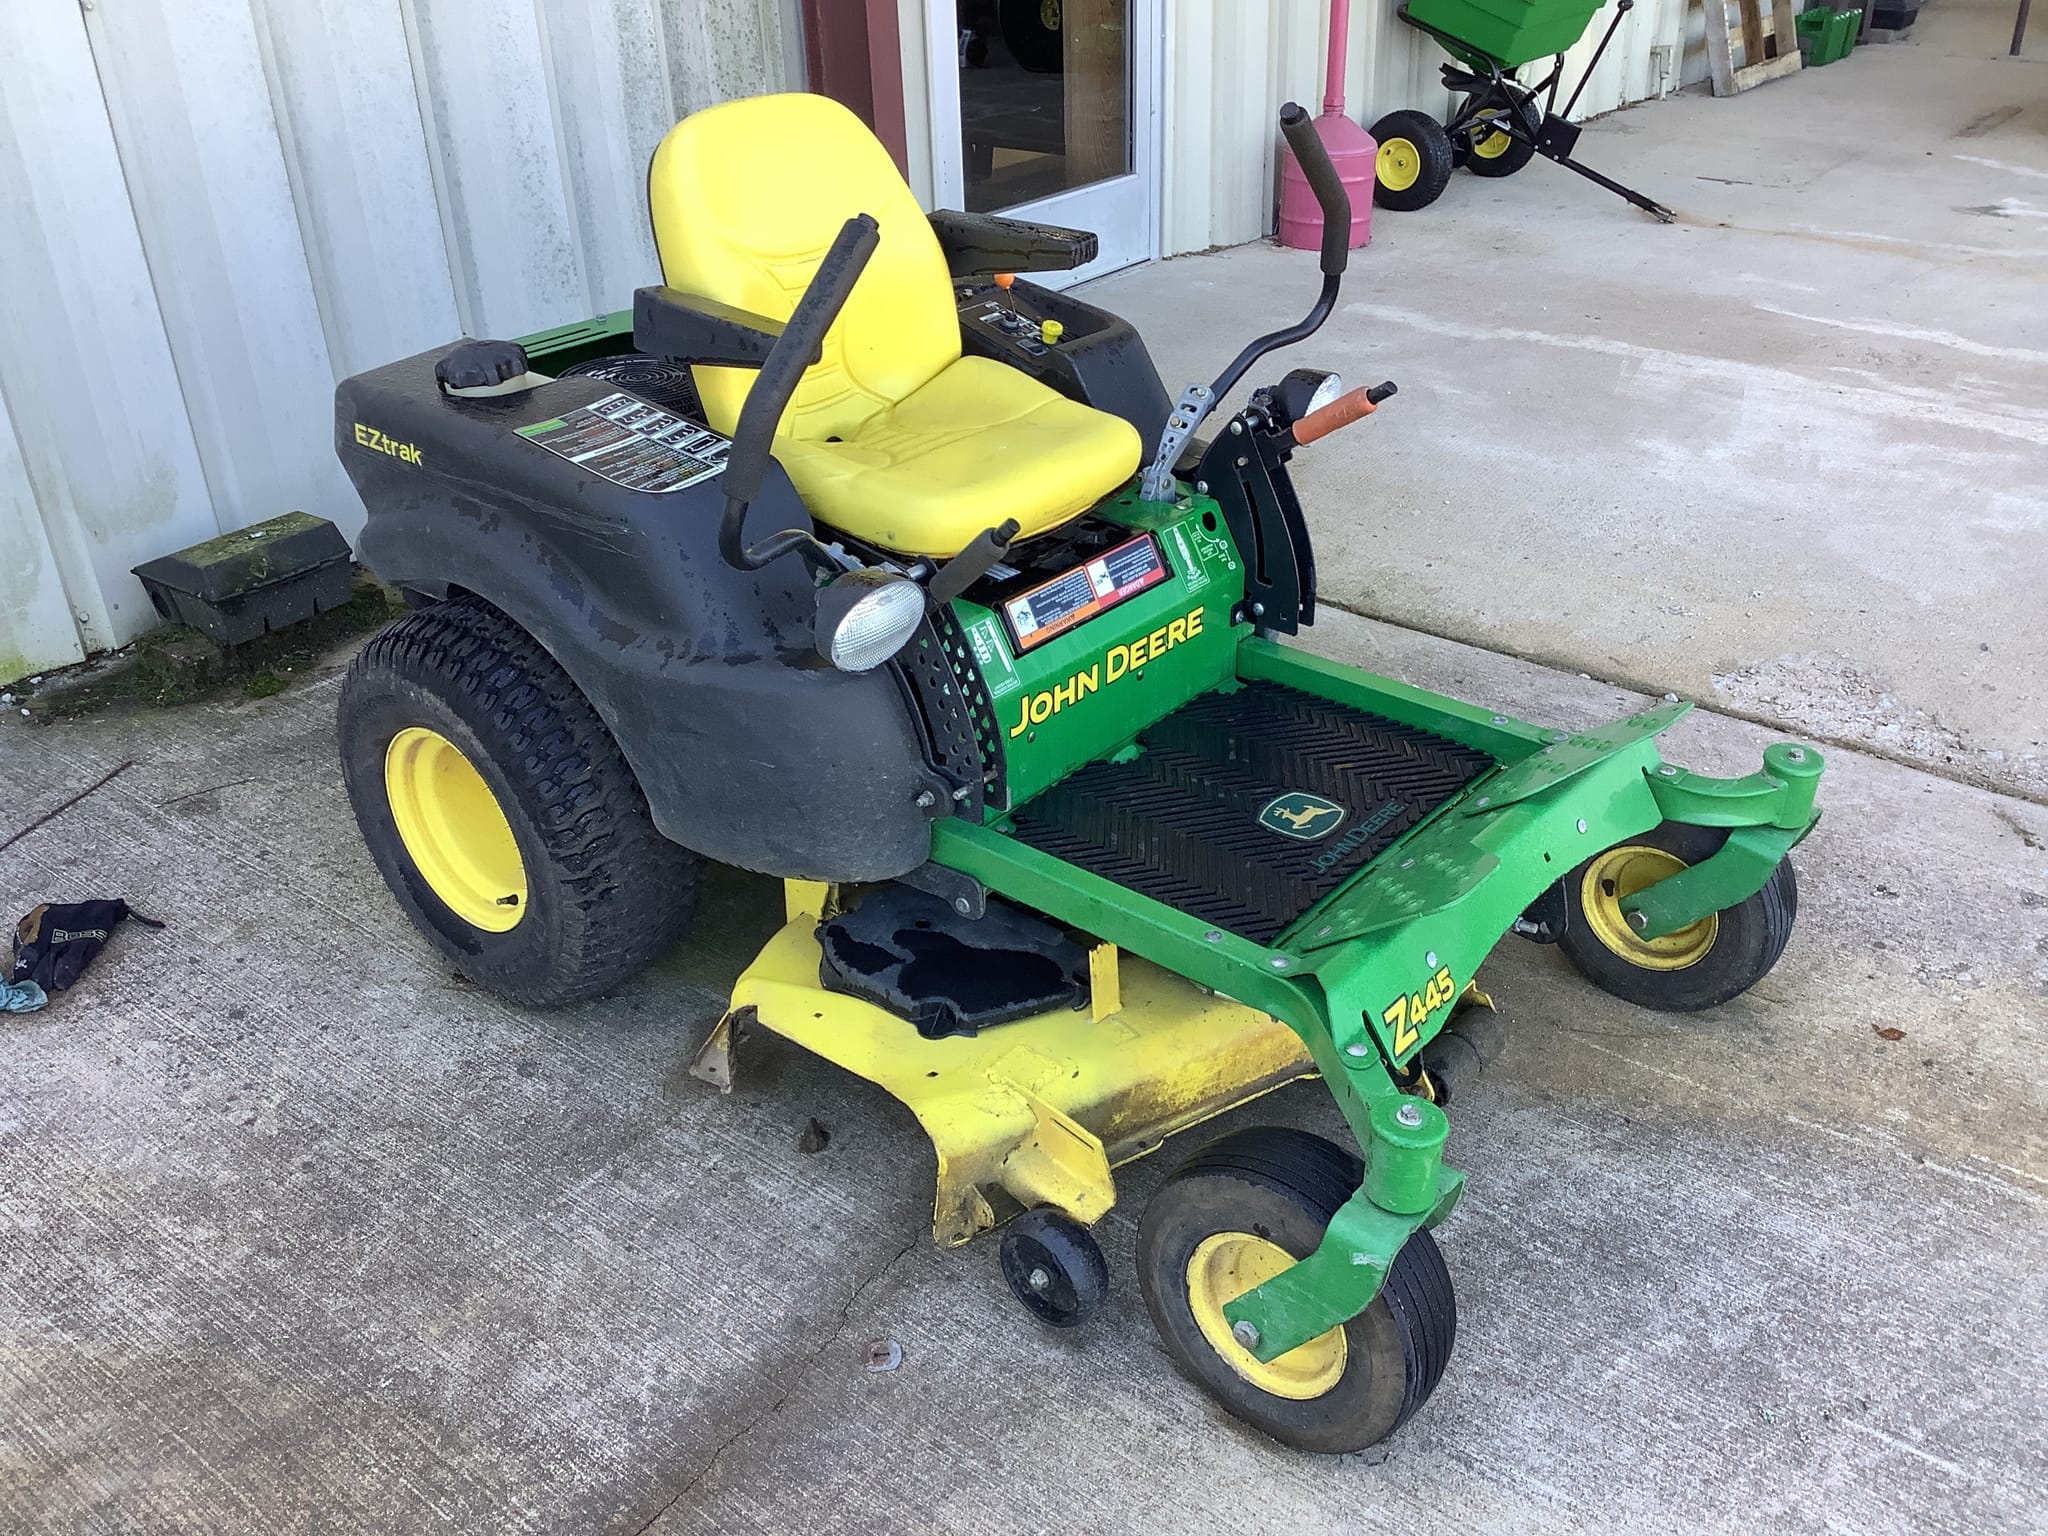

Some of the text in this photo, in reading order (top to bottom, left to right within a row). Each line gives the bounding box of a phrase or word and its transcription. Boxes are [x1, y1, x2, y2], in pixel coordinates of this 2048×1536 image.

[354, 422, 423, 466] EZtrak
[1010, 606, 1204, 739] JOHN DEERE
[1310, 801, 1405, 874] JOHN DEERE
[1382, 964, 1455, 1058] Z445
